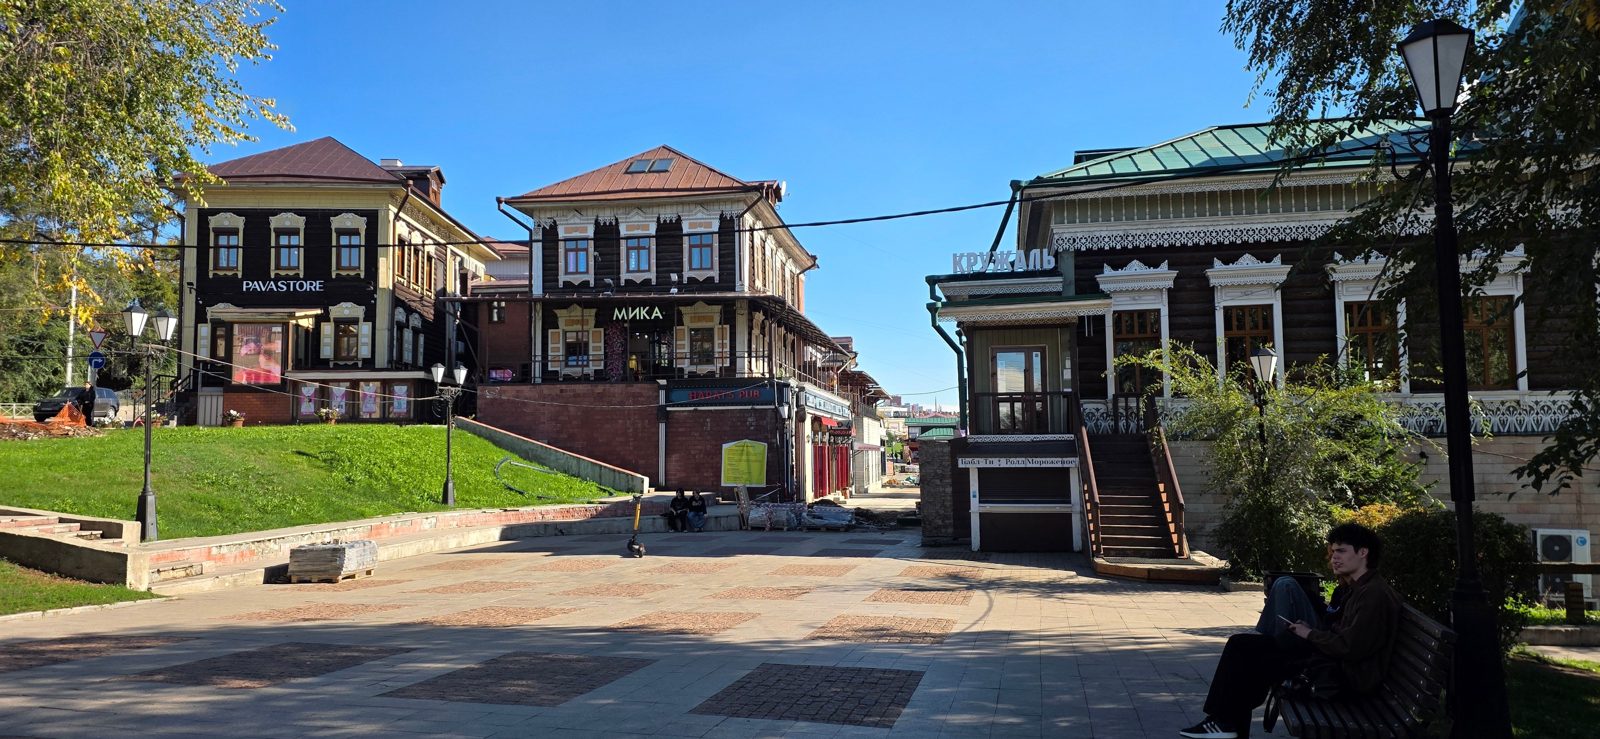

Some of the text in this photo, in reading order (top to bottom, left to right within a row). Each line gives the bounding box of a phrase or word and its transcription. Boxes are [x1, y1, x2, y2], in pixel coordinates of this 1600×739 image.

[952, 248, 1056, 274] КРУЖАЛЬ
[612, 306, 663, 321] МИКА
[739, 390, 760, 398] PUB
[1027, 458, 1076, 466] Мороженое
